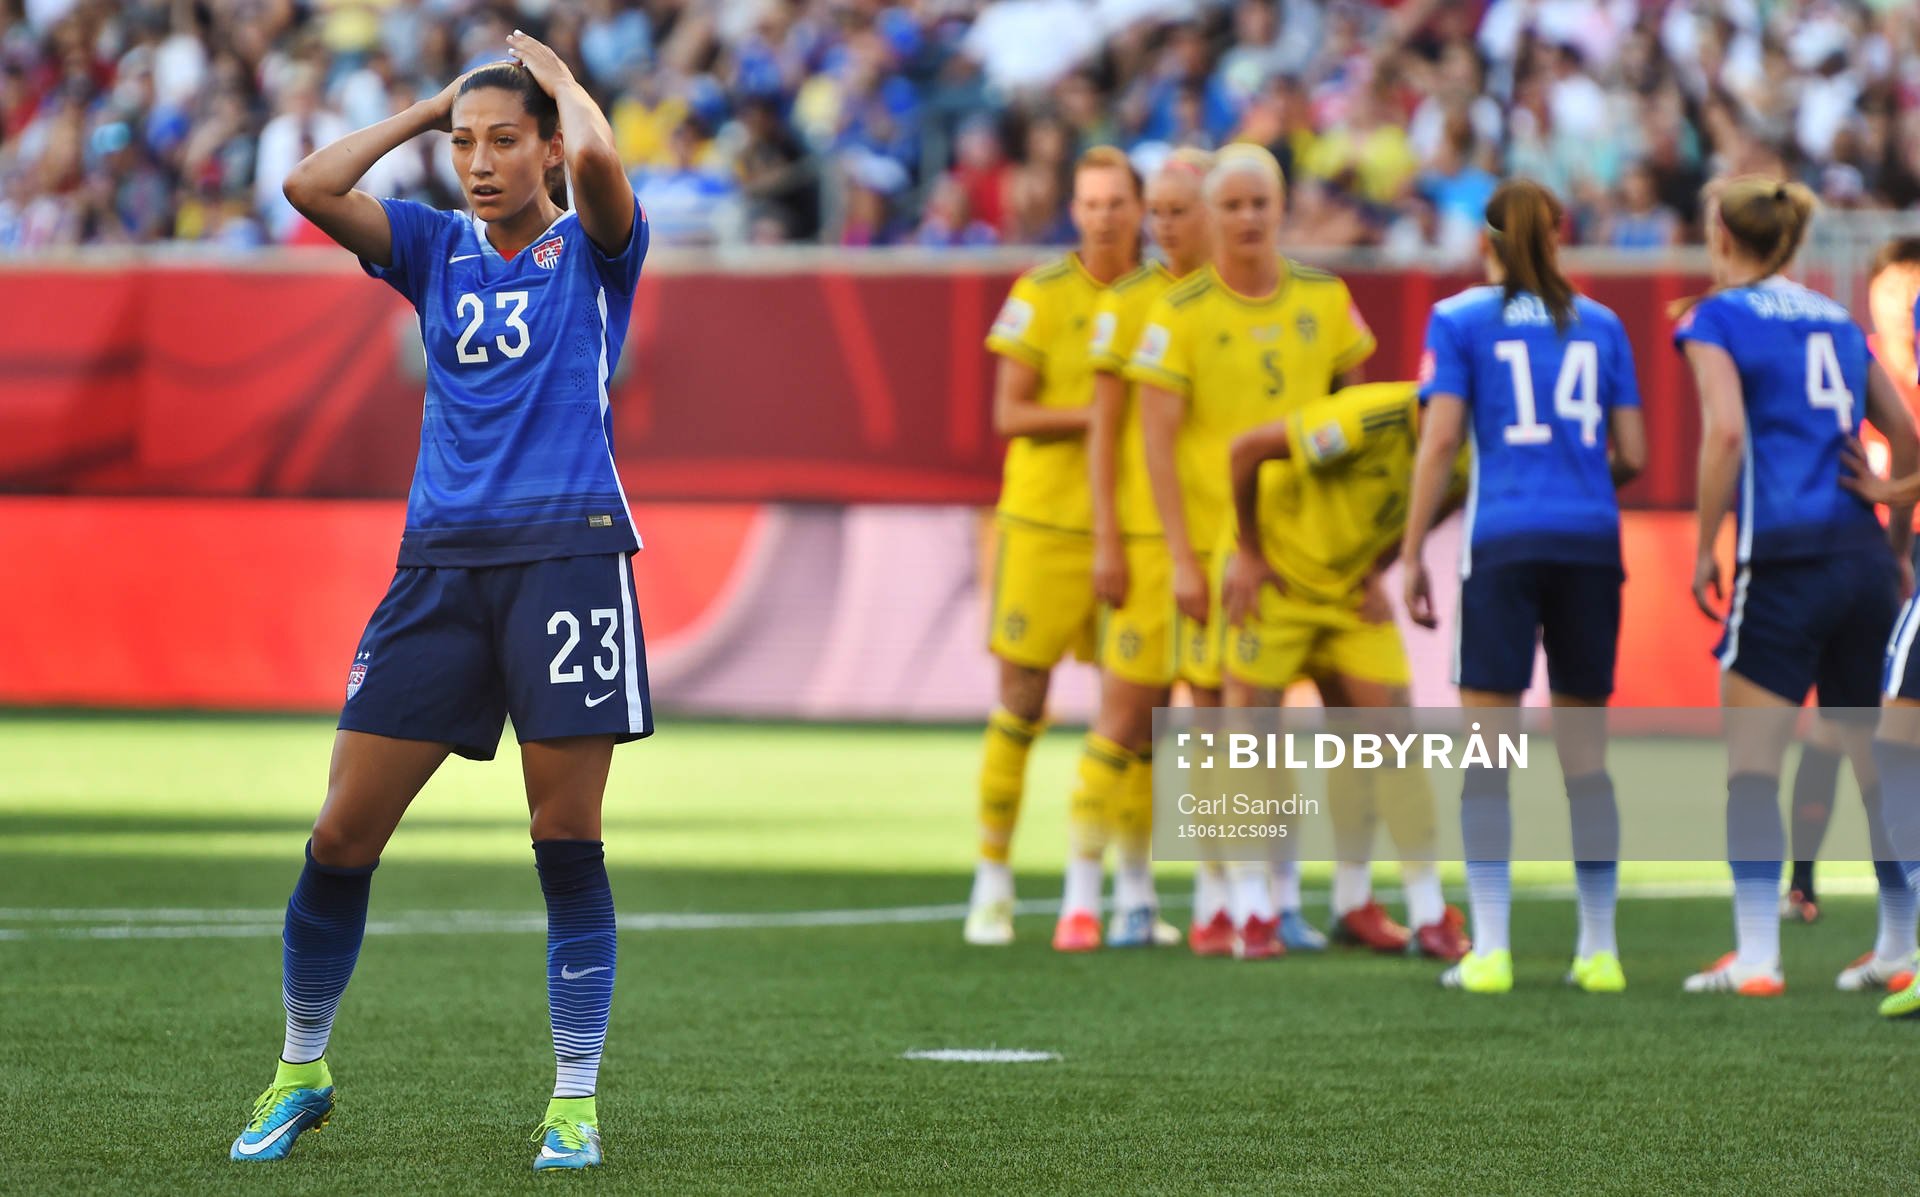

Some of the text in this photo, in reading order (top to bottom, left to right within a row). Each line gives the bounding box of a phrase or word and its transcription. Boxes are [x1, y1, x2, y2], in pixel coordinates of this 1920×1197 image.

[455, 290, 531, 364] 23
[1494, 339, 1603, 446] 14
[1806, 331, 1855, 431] 4
[546, 608, 620, 684] 23
